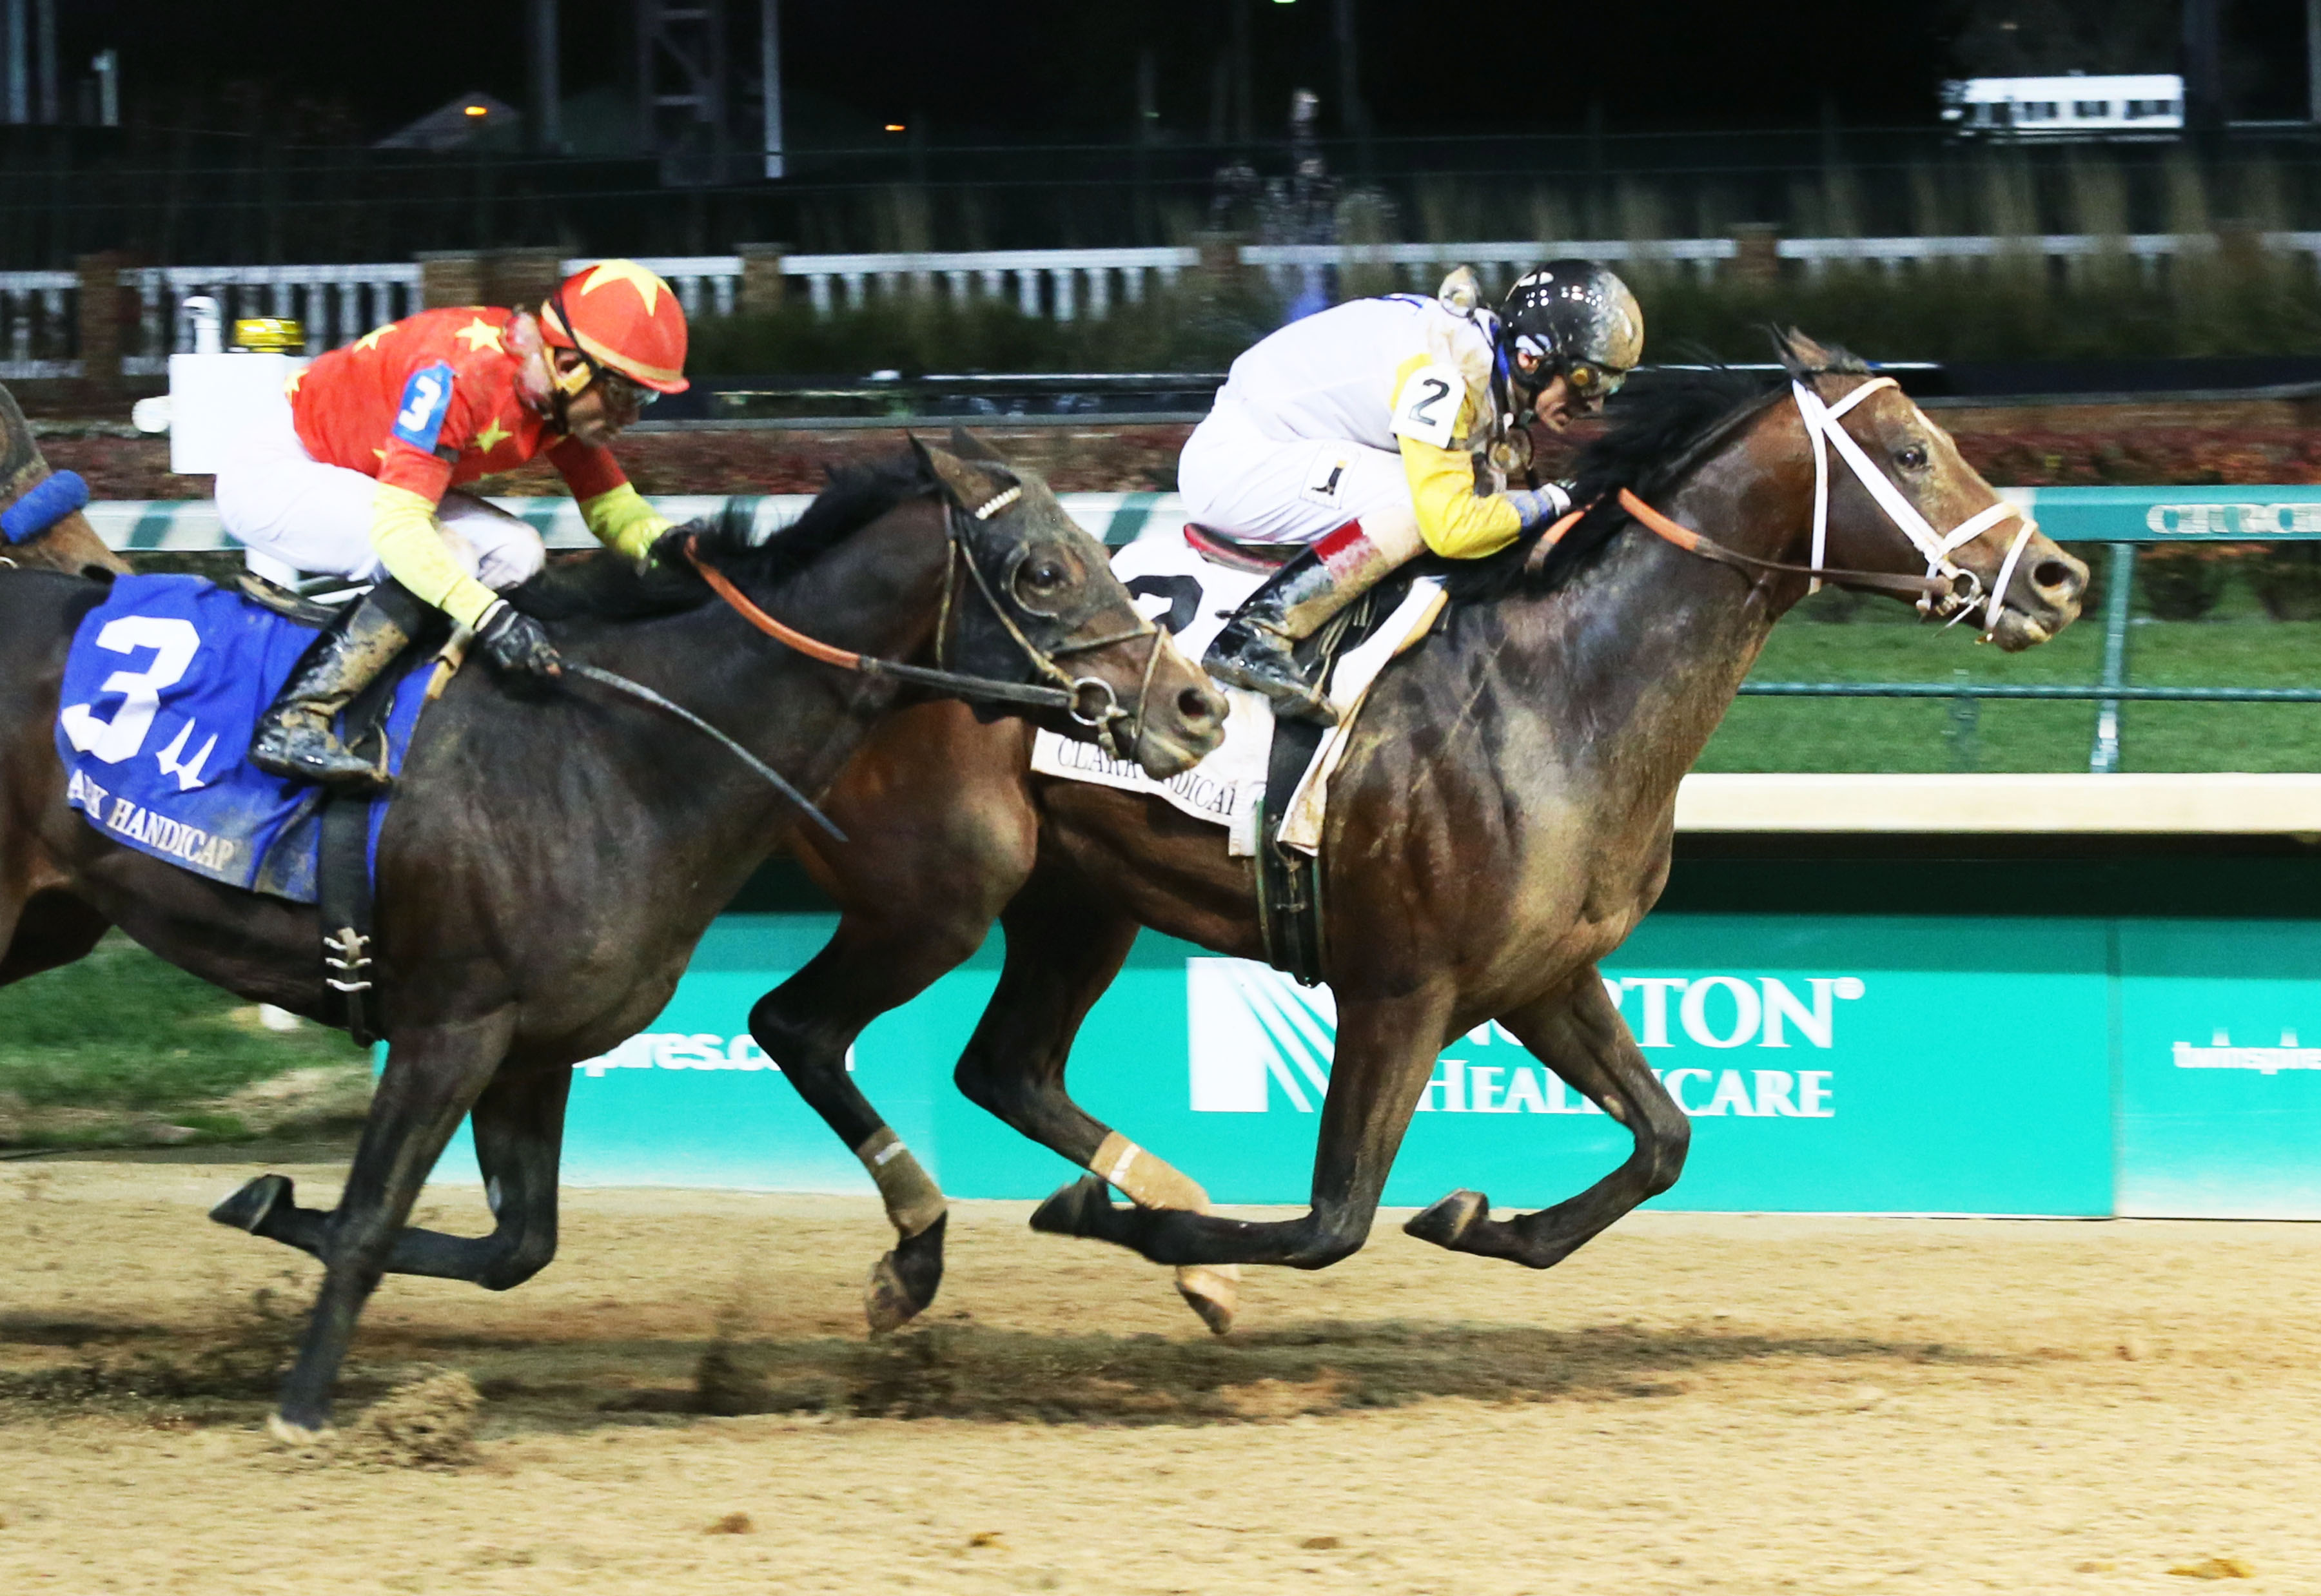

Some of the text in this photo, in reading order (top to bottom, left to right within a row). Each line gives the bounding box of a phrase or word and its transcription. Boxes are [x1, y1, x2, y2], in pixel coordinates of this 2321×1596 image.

[398, 375, 442, 433] 3
[1408, 378, 1449, 426] 2
[61, 615, 201, 764] 3
[106, 797, 235, 871] HANDICAP
